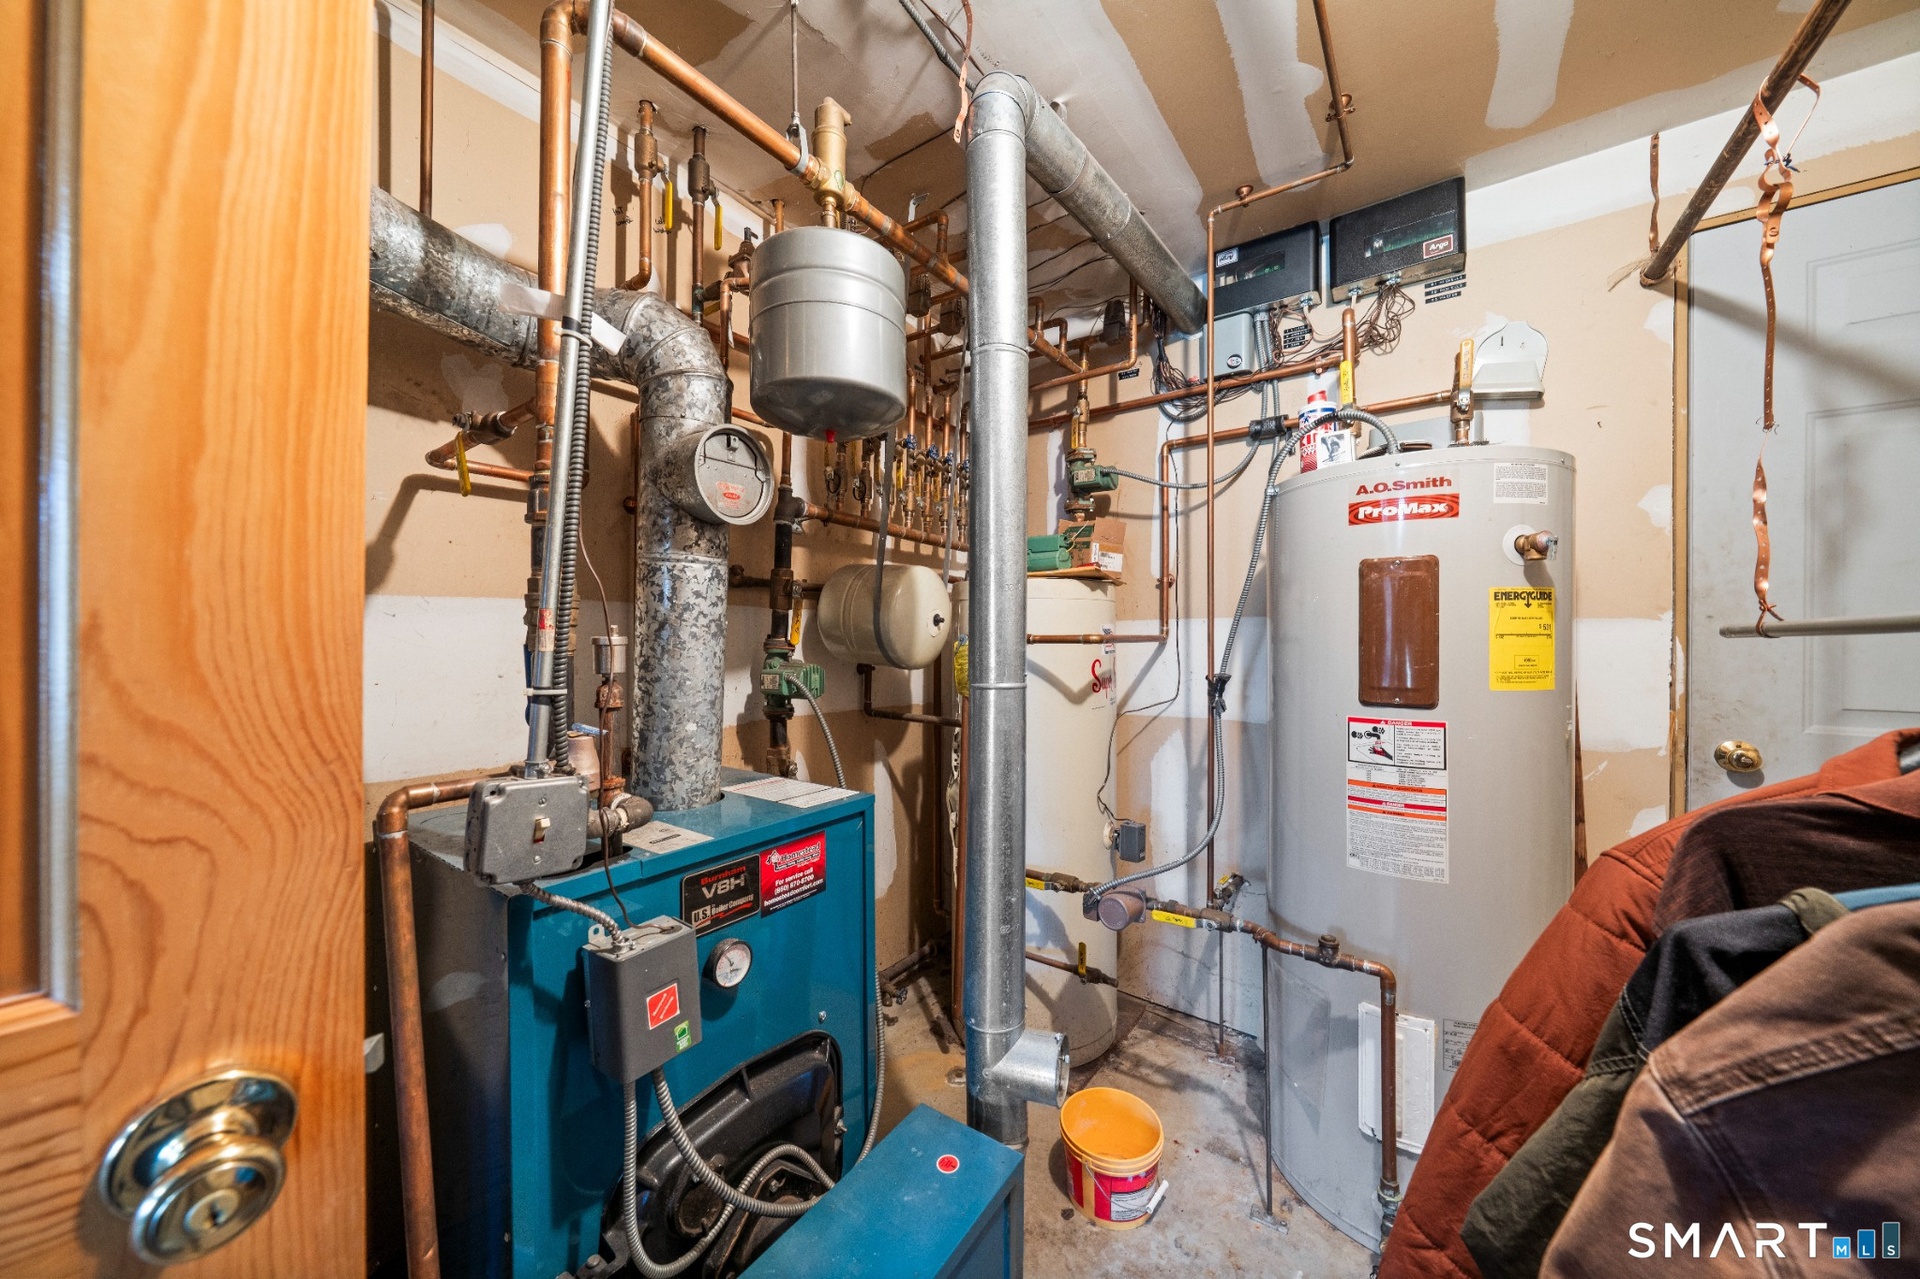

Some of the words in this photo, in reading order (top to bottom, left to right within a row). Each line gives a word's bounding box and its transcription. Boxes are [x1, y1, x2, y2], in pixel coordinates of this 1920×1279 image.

[1429, 241, 1449, 251] Argo
[1356, 476, 1452, 496] A.O.Smith
[1358, 502, 1449, 519] ProMax
[781, 841, 821, 862] Homestead
[701, 865, 746, 885] Burnham
[775, 878, 784, 887] For
[785, 871, 803, 883] service
[804, 866, 813, 876] call
[701, 874, 745, 899] V8H
[694, 909, 710, 923] U.S.
[729, 894, 754, 908] Company
